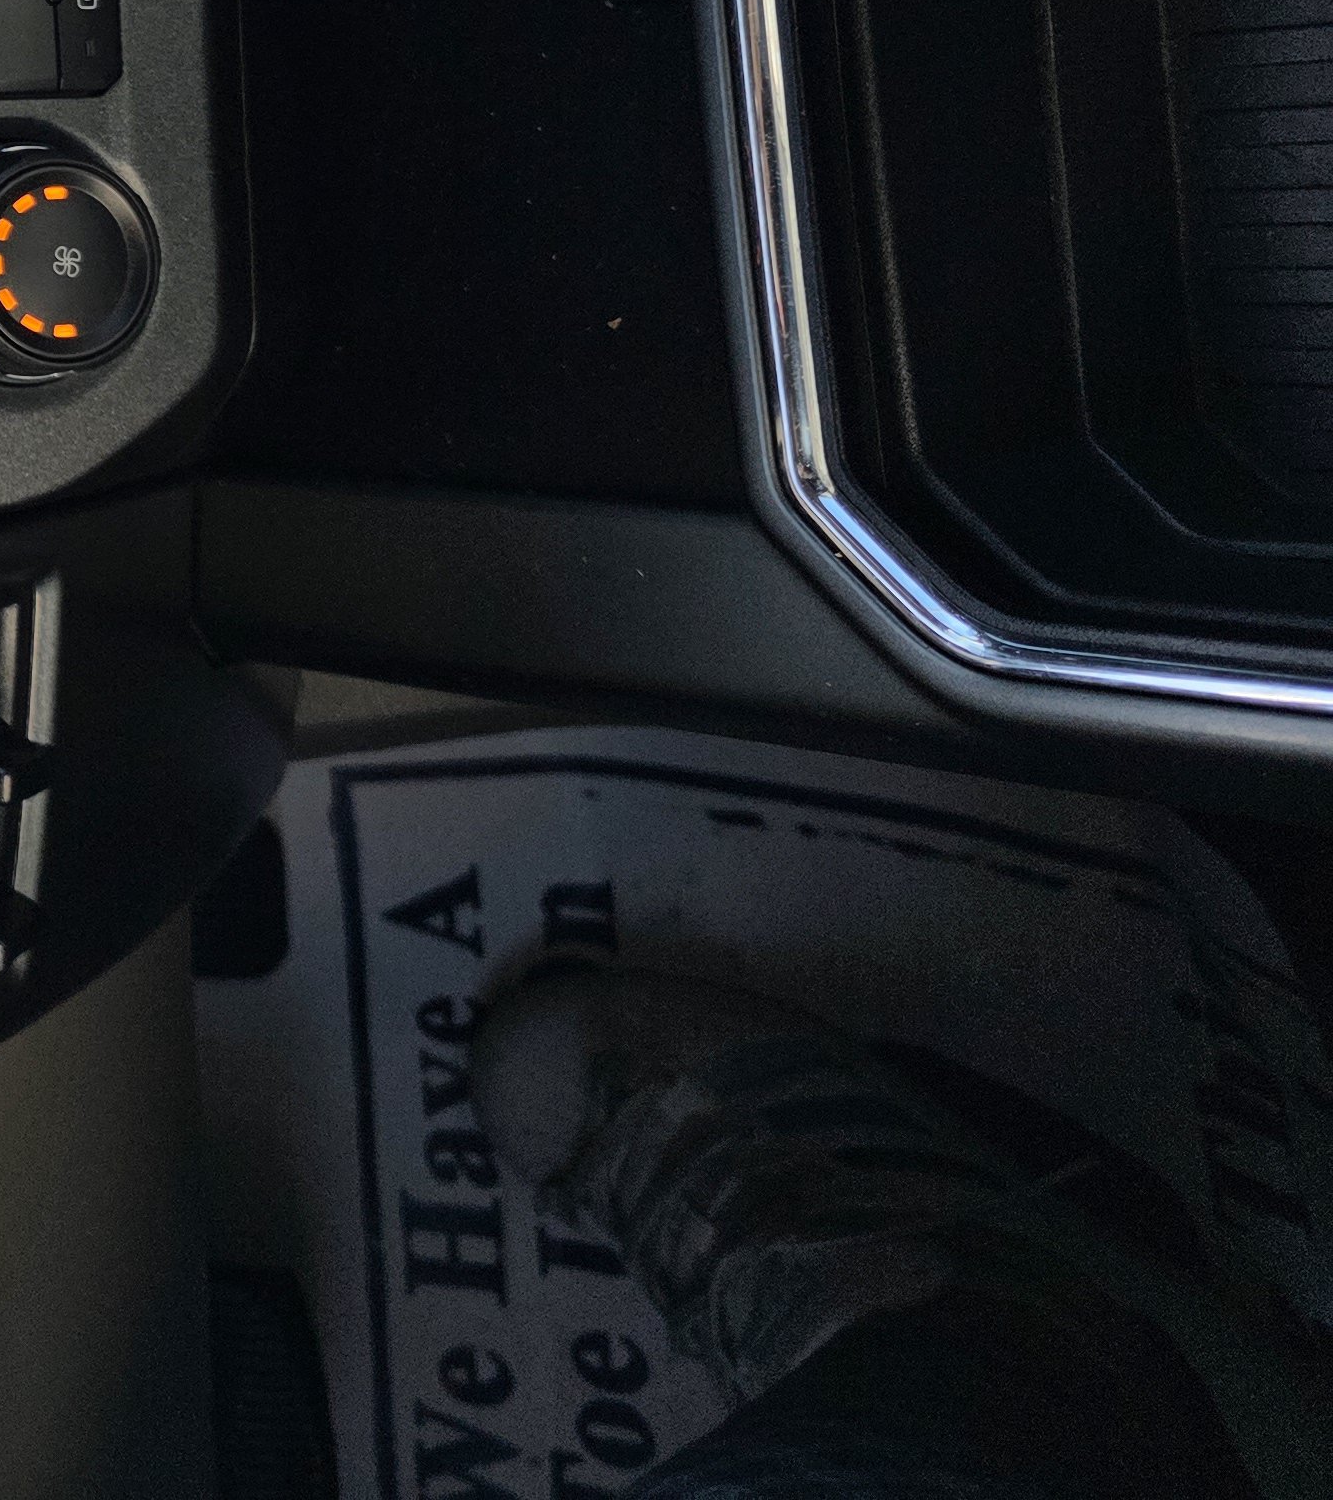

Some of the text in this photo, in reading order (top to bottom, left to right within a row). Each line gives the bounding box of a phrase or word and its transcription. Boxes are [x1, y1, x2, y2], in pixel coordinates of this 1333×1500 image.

[380, 862, 522, 1500] We Have A
